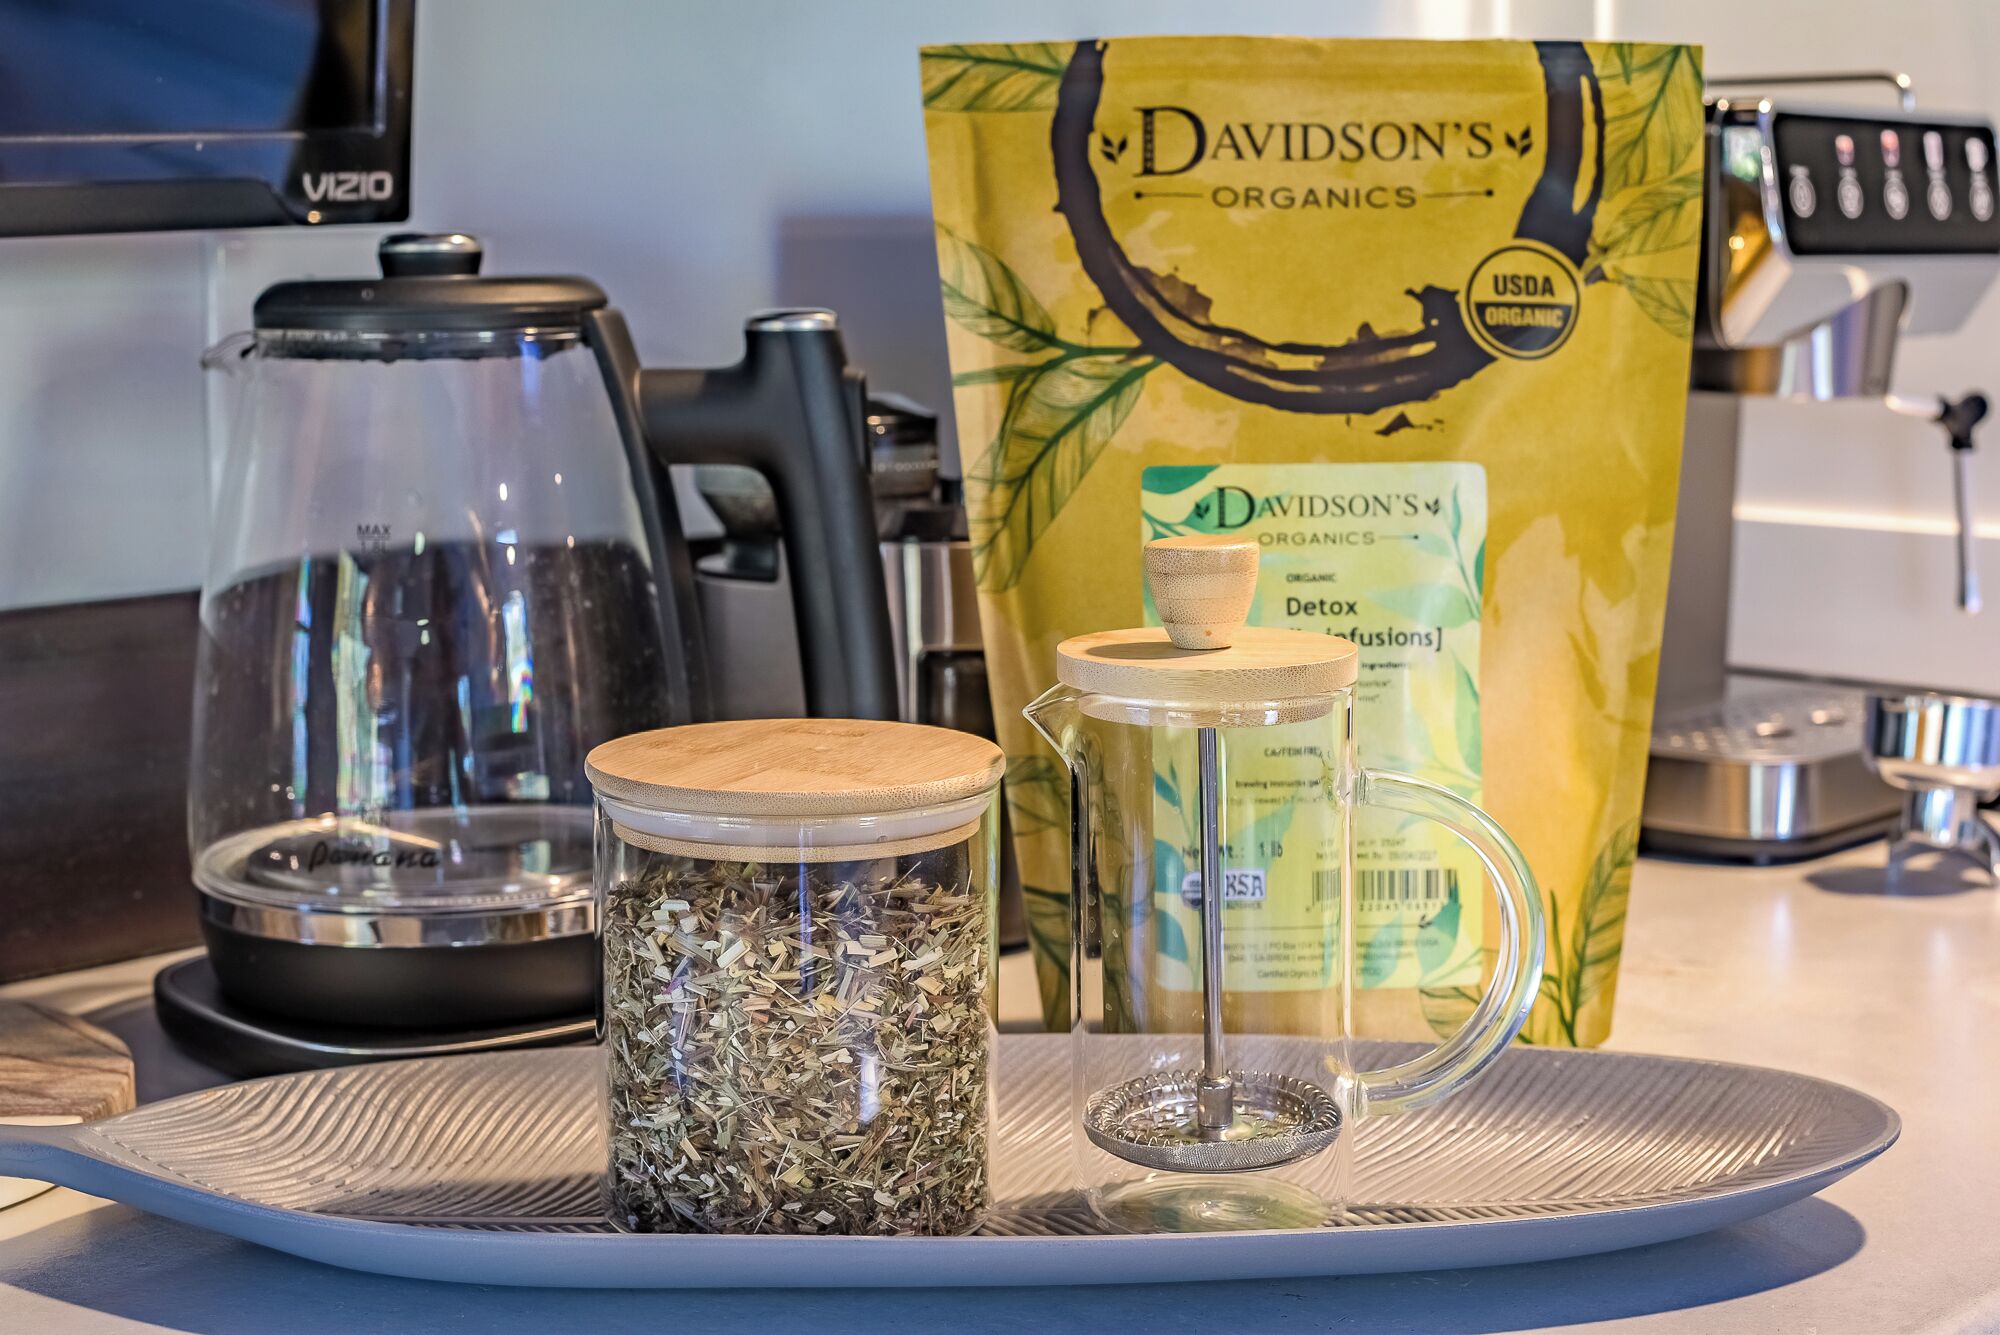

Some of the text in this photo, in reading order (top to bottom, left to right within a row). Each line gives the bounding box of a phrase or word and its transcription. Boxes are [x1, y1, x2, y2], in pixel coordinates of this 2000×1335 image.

[1133, 105, 1494, 177] DAVIDSON'S
[302, 170, 394, 202] VIZIO
[1211, 185, 1417, 210] ORGANICS
[1493, 273, 1555, 298] USDA
[1484, 305, 1564, 329] ORGANIC
[1216, 485, 1419, 529] DAVIDSON'S
[356, 523, 392, 538] MAX
[1258, 530, 1376, 547] ORGANICS
[1285, 573, 1337, 584] ORGANIC
[1286, 596, 1359, 617] Detox
